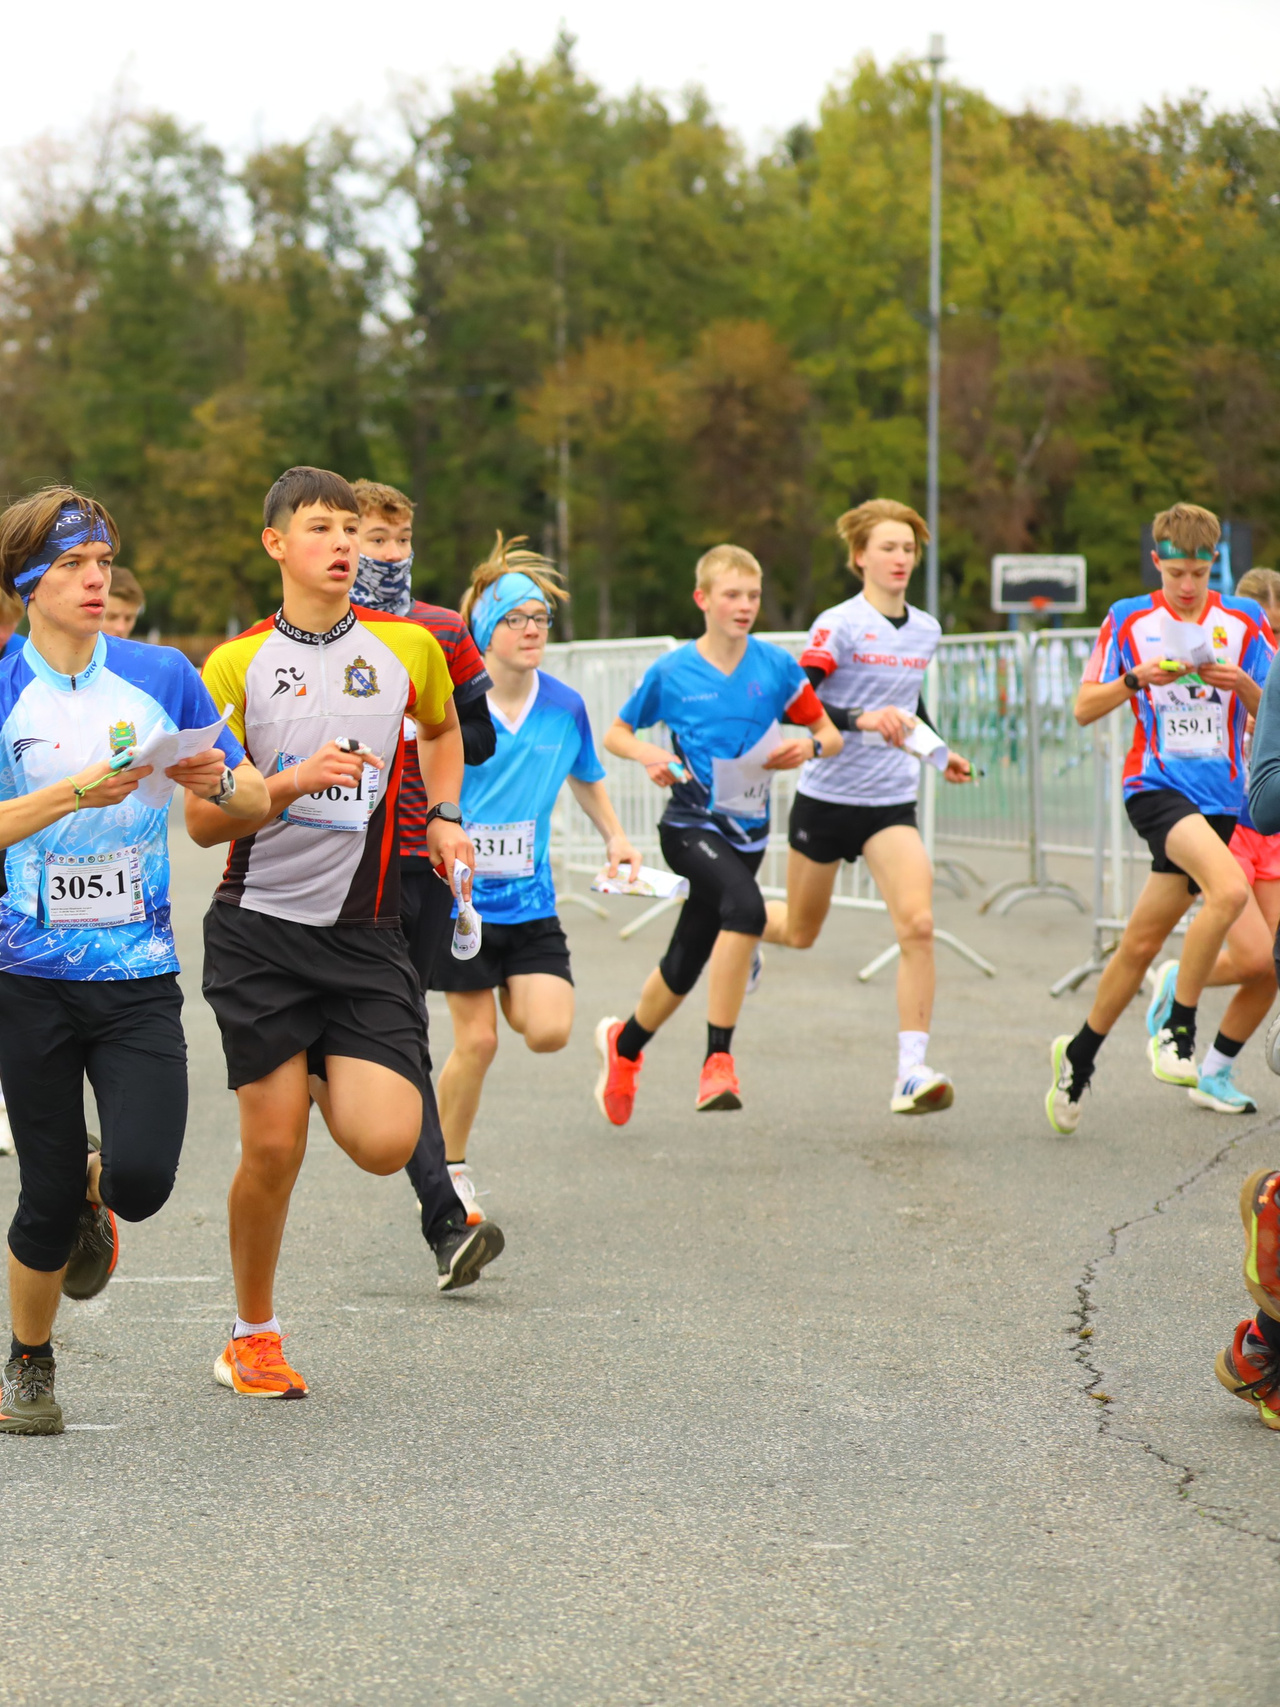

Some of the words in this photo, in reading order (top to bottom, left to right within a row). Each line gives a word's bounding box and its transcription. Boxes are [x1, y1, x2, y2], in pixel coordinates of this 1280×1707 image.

[1168, 717, 1213, 736] 359.1
[472, 836, 523, 857] 331.1
[50, 869, 128, 901] 305.1
